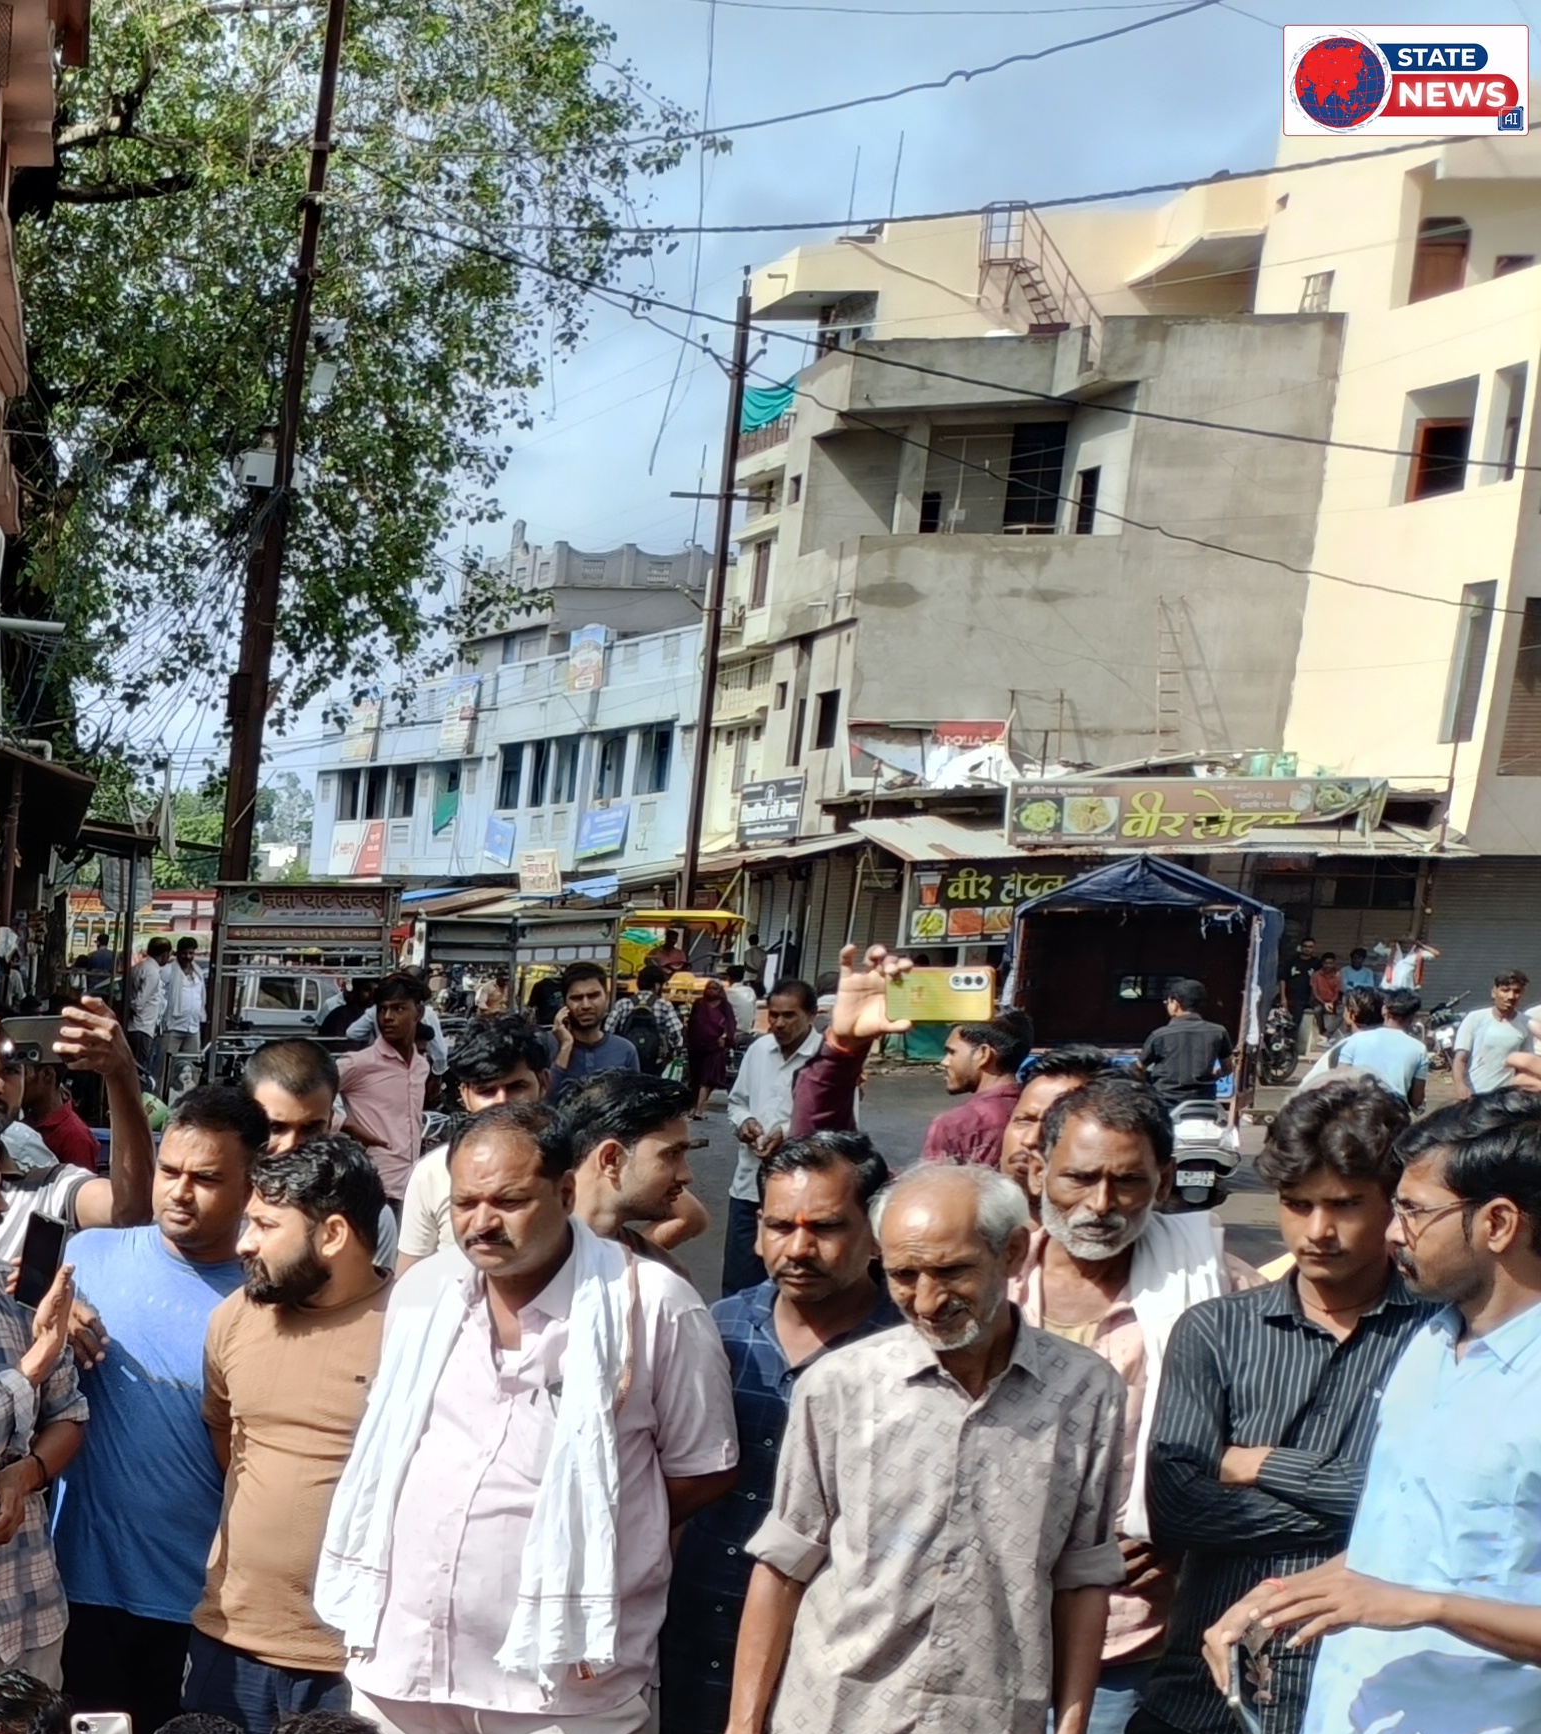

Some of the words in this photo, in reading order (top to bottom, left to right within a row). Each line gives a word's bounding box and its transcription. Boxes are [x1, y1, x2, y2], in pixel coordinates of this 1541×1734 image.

[1120, 790, 1191, 838] वीर
[301, 892, 335, 910] चाट
[946, 867, 994, 900] वीर
[999, 866, 1067, 904] होटल
